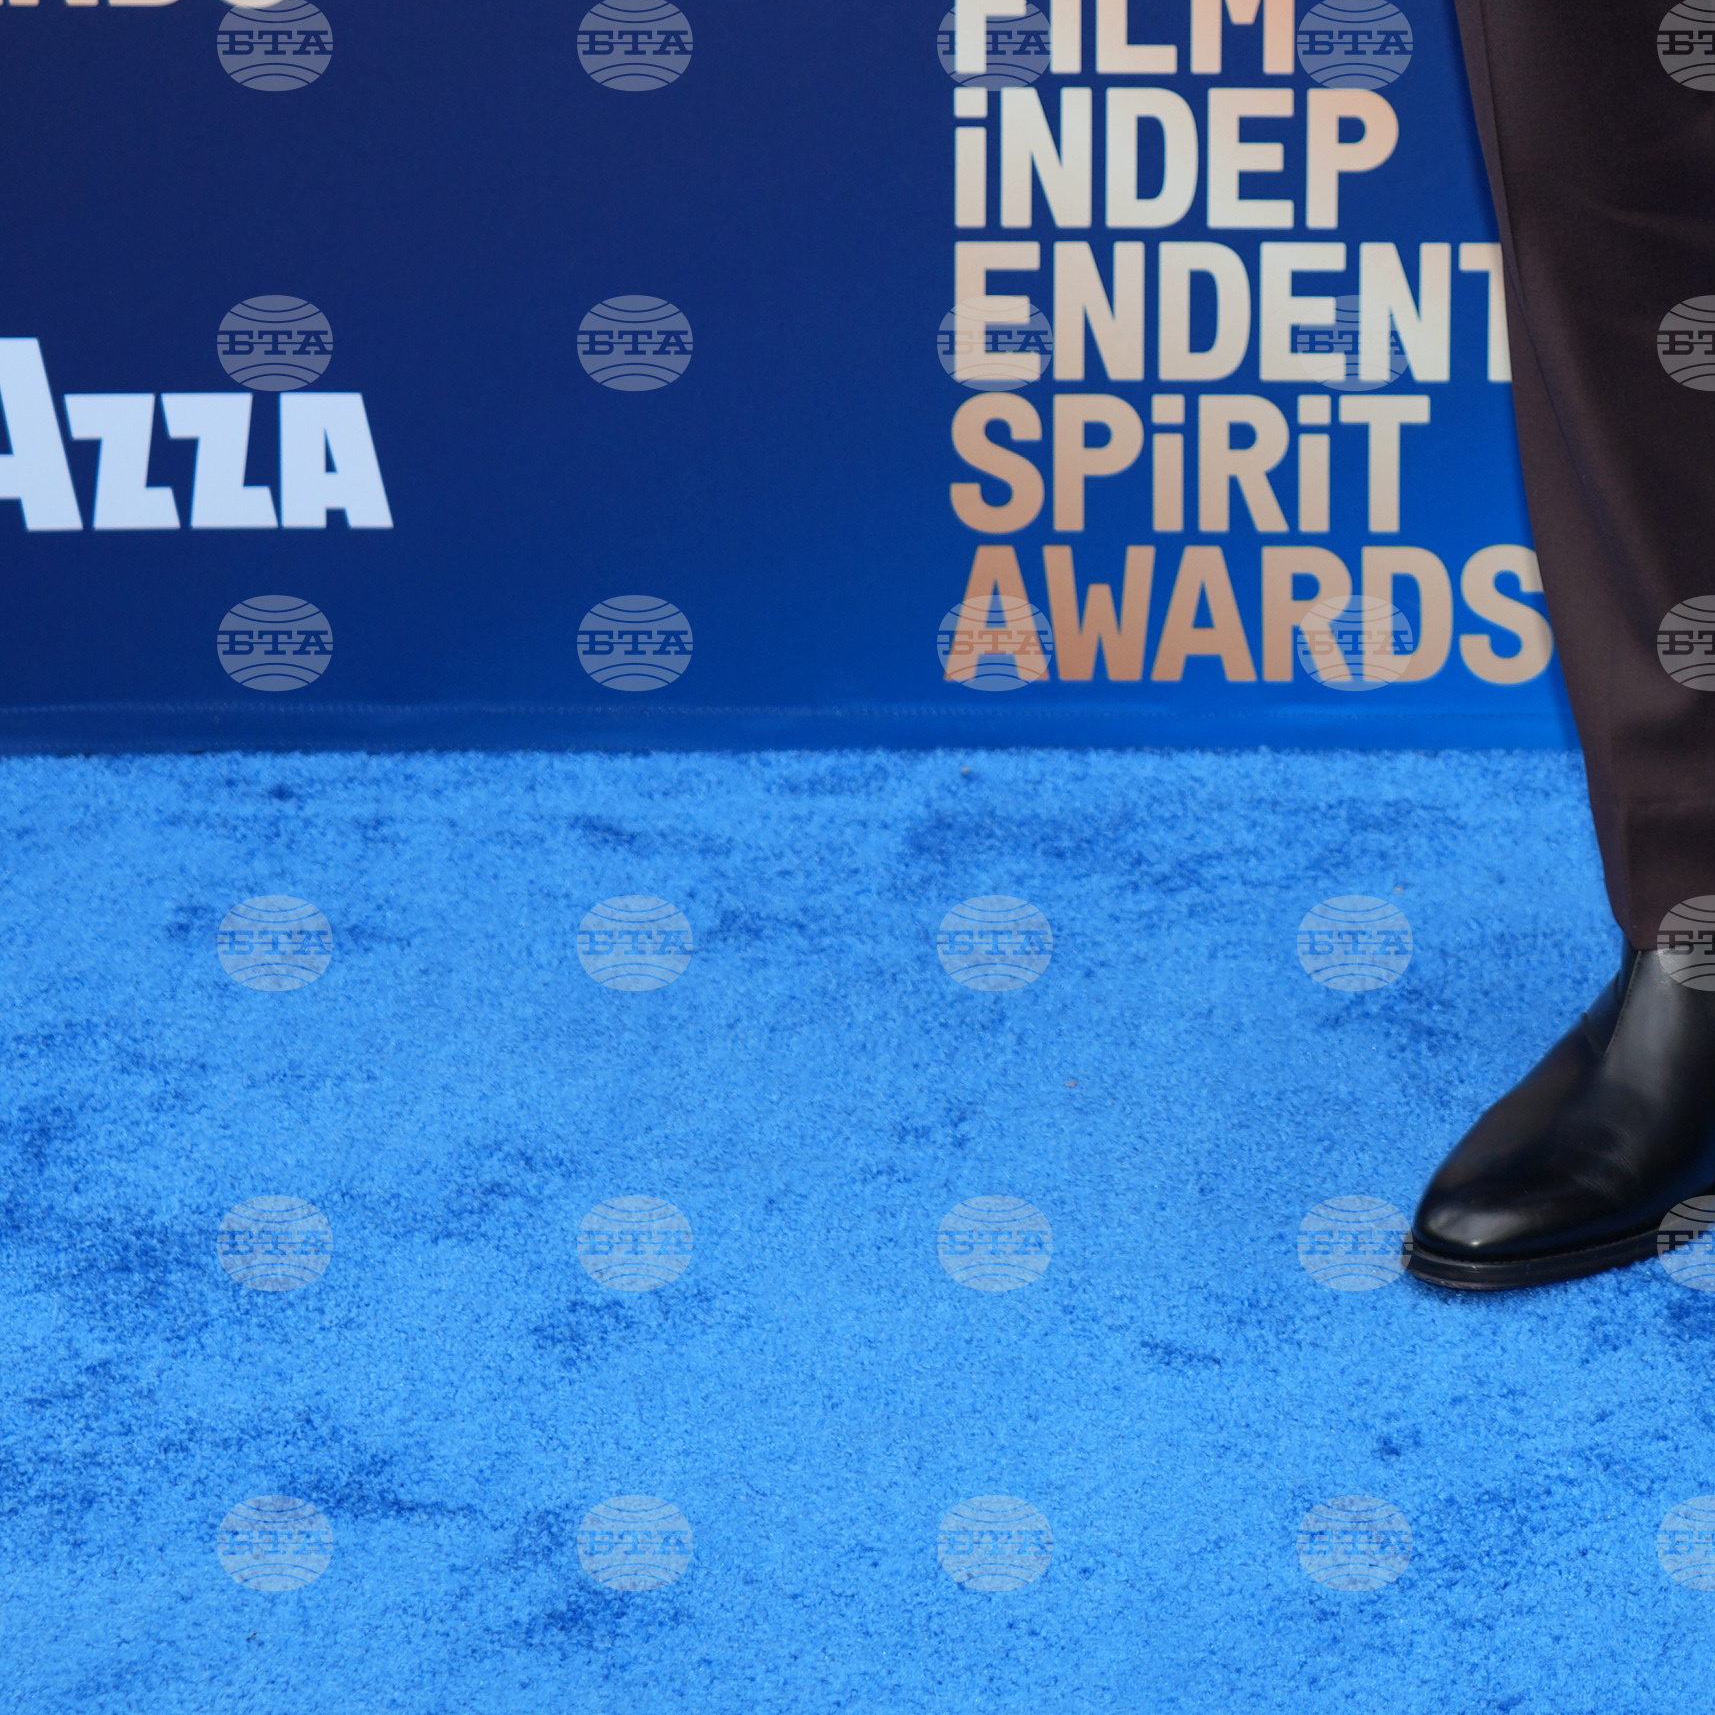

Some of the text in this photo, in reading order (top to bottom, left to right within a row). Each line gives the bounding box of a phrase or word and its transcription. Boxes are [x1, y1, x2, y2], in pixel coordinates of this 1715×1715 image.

[953, 86, 1399, 230] iNDEP
[949, 393, 1430, 533] SPiRiT
[943, 543, 1553, 685] AWARDS
